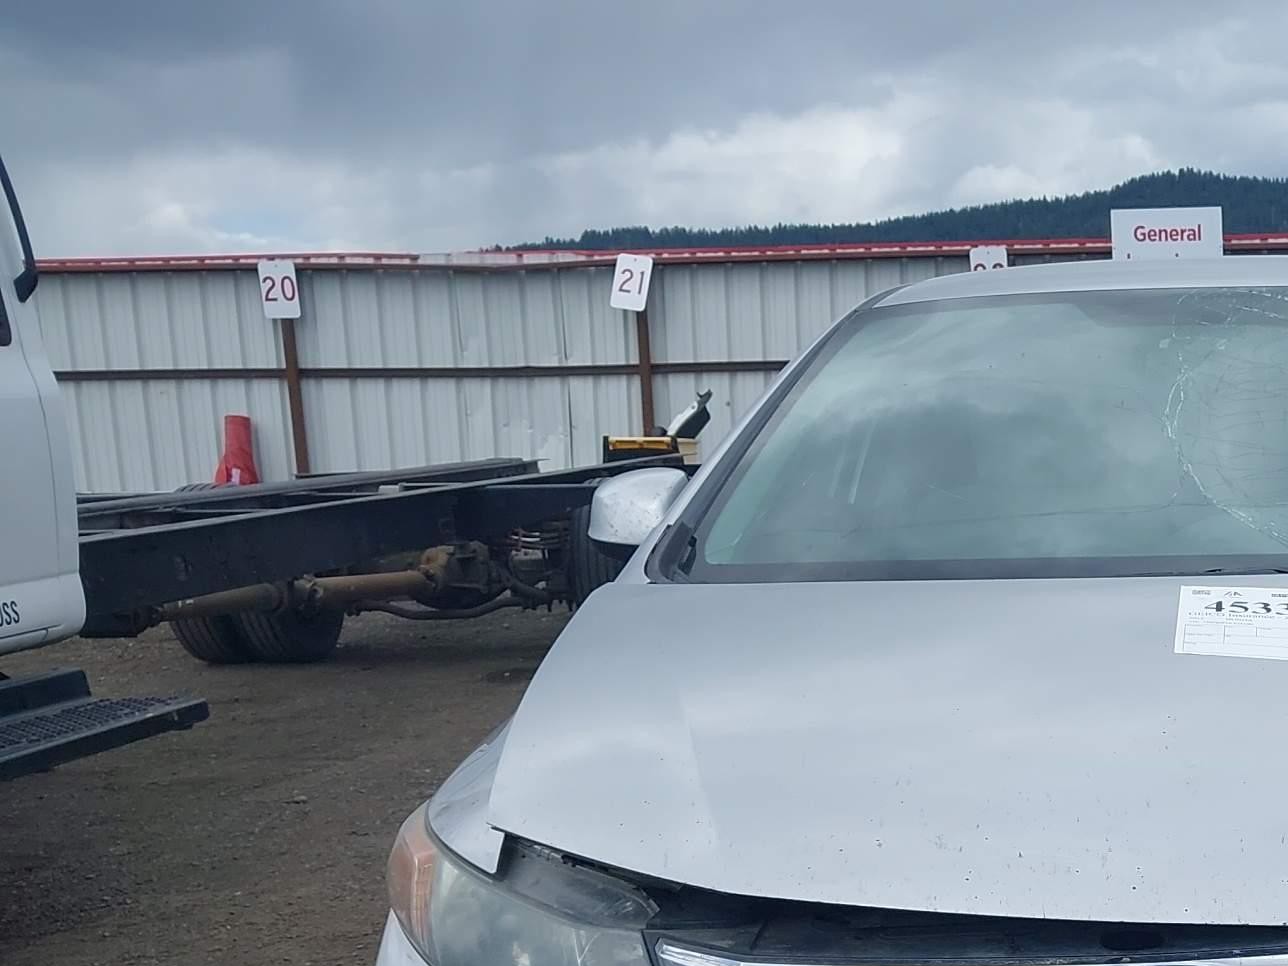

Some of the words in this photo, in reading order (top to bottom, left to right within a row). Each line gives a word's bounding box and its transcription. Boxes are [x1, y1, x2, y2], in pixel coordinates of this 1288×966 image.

[1133, 224, 1202, 243] General
[262, 275, 296, 302] 20
[618, 268, 646, 295] 21
